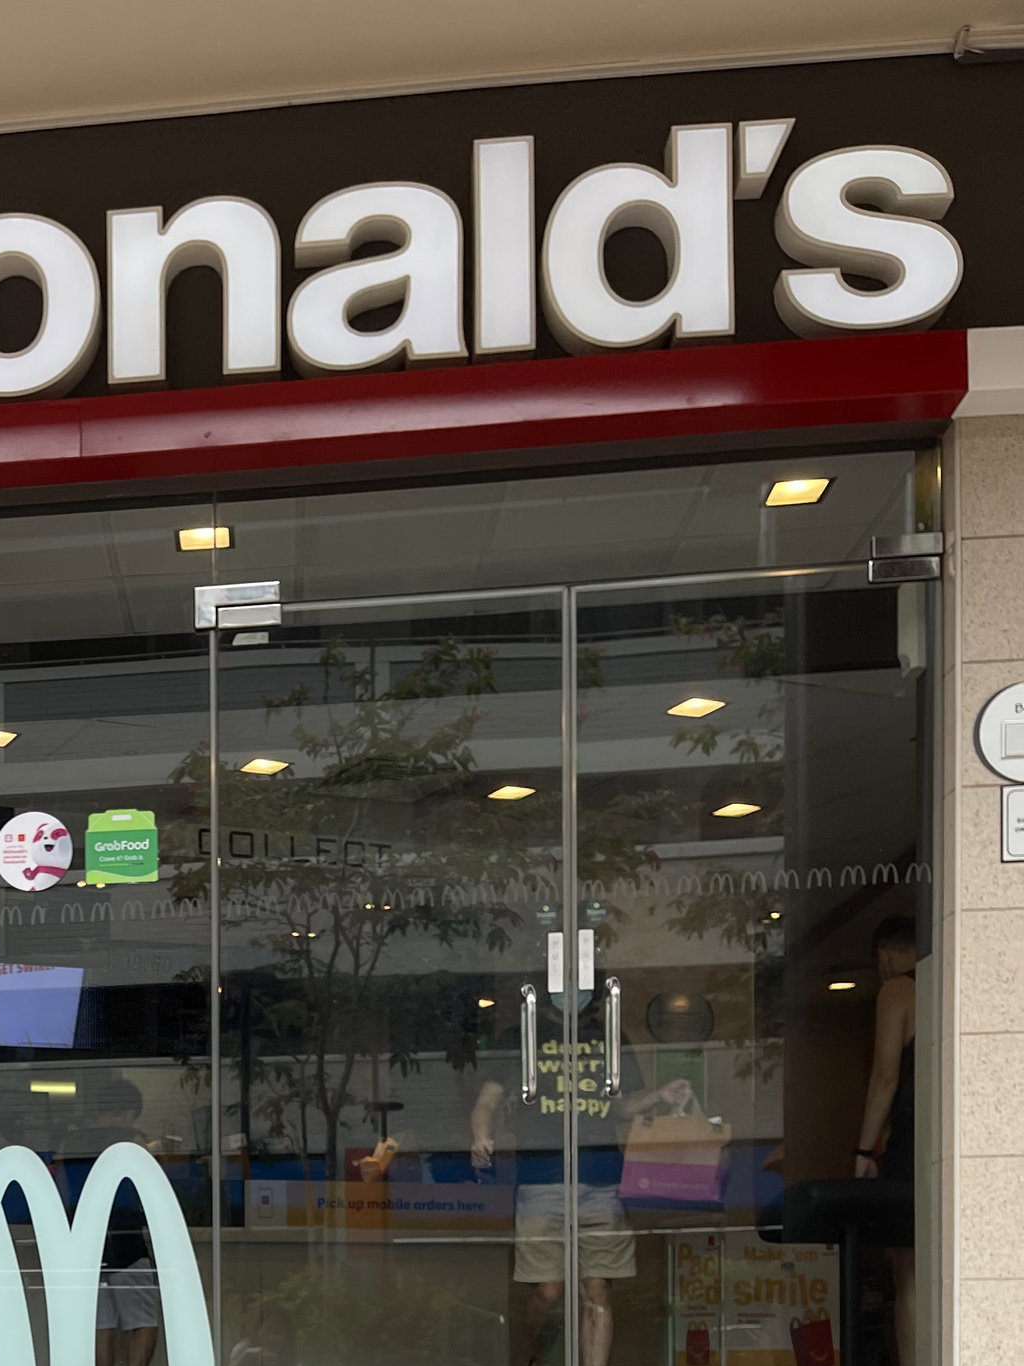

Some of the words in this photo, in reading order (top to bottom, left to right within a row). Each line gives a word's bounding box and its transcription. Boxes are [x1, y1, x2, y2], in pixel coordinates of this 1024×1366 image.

[94, 838, 150, 852] GrabFood
[198, 828, 392, 868] COLLECT
[540, 1095, 611, 1118] happy
[317, 1196, 344, 1210] Pick
[348, 1199, 363, 1213] up
[367, 1197, 410, 1211] mobile
[414, 1198, 454, 1212] orders
[457, 1199, 486, 1212] here
[734, 1271, 829, 1307] smile
